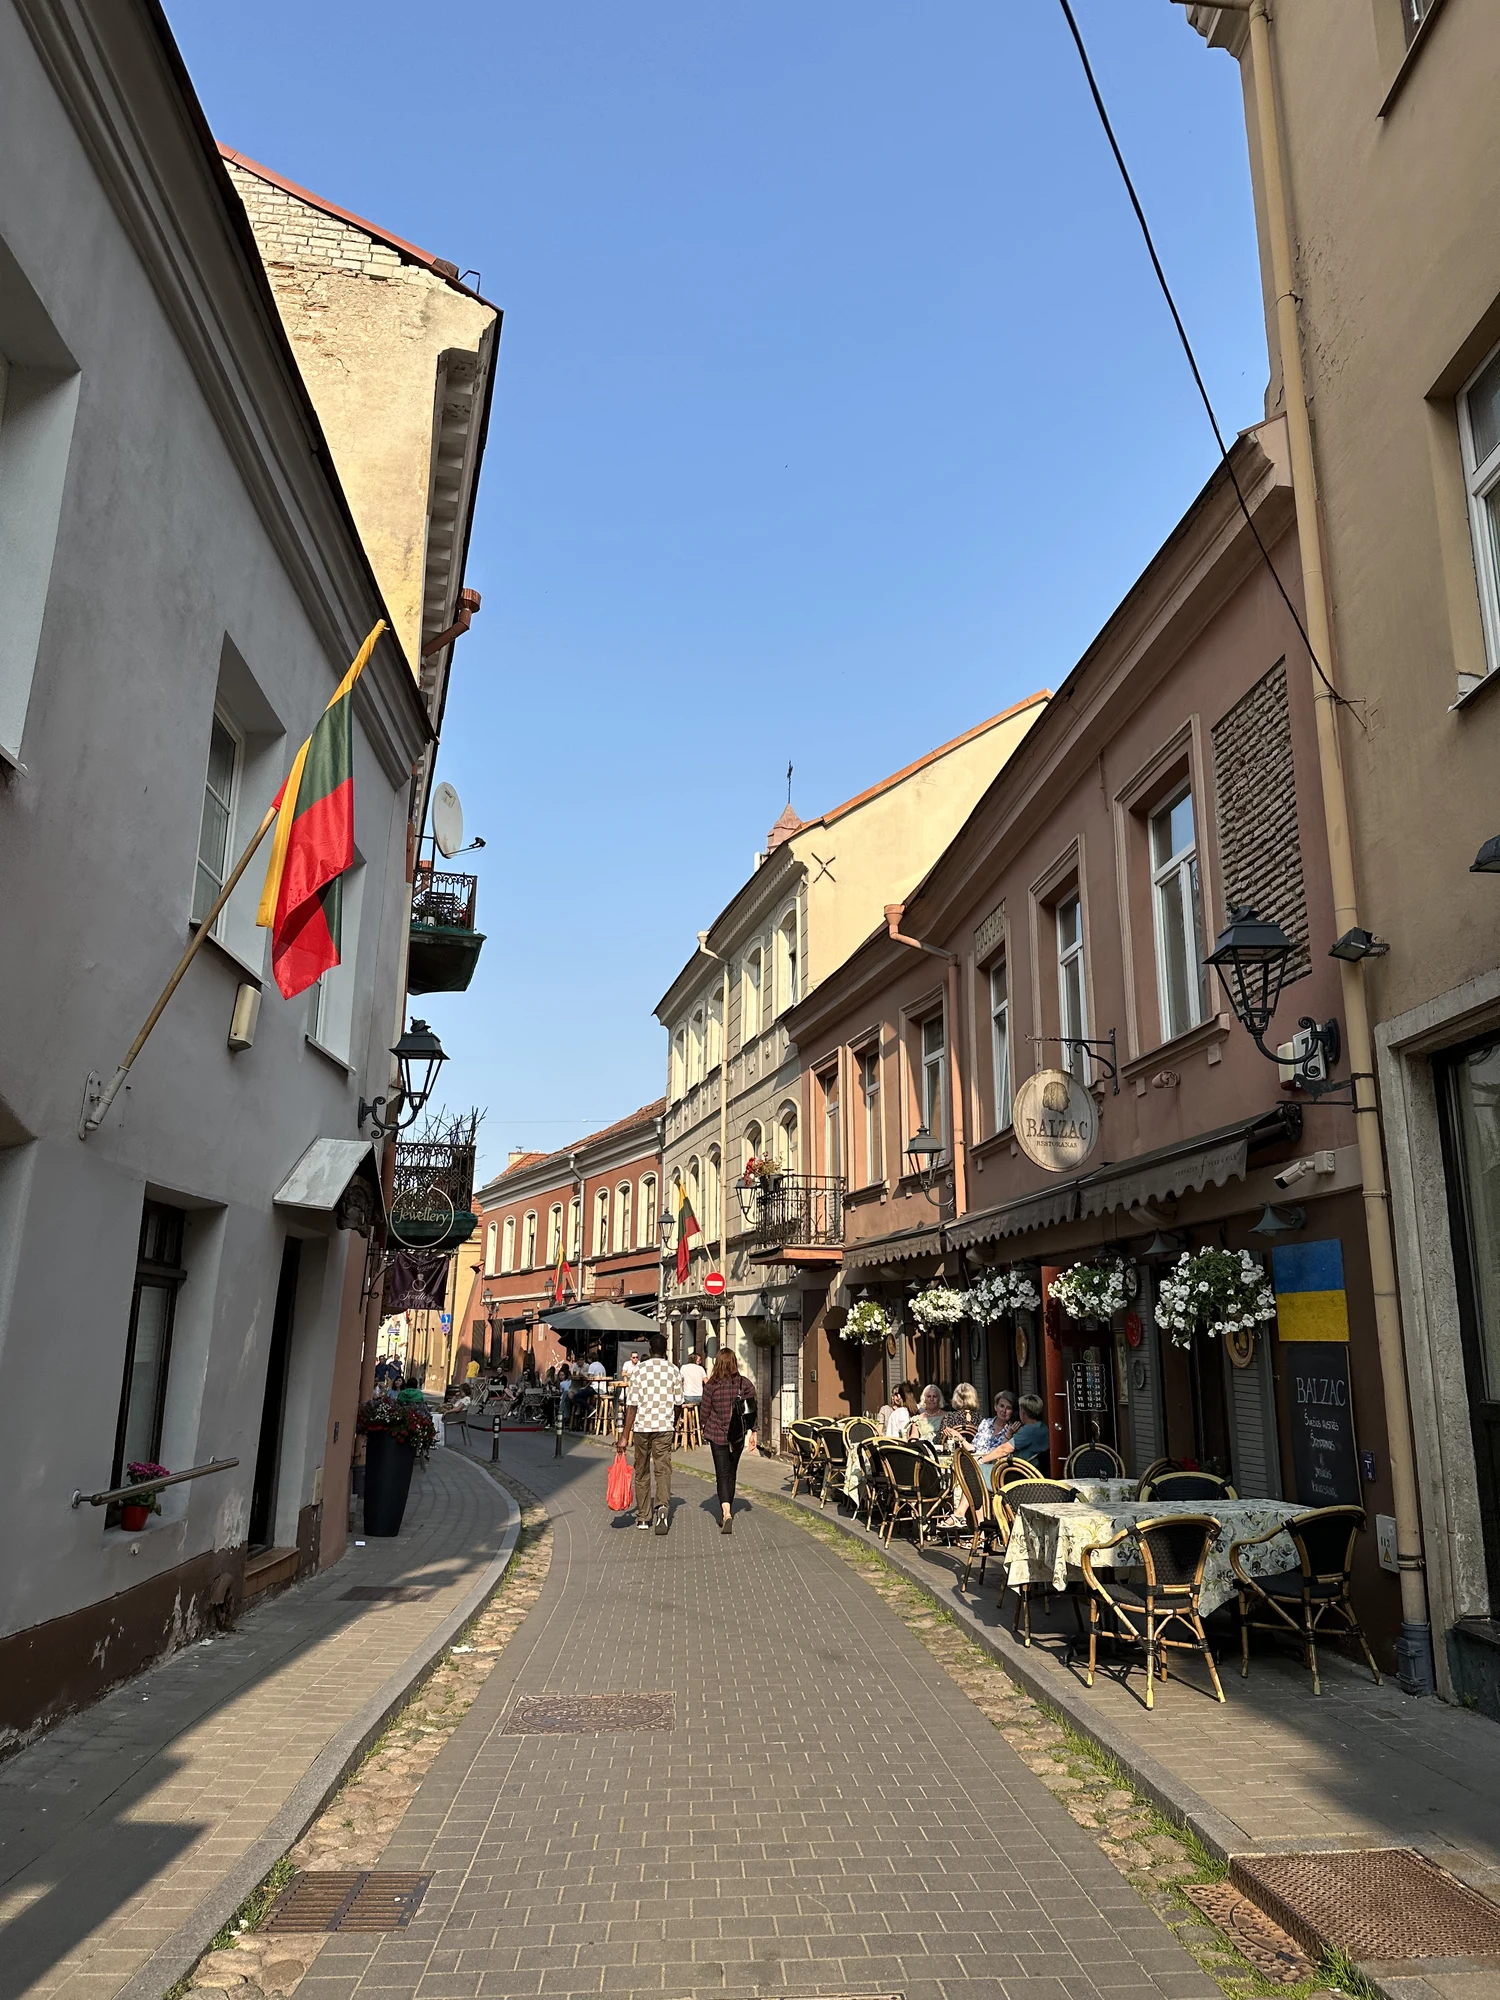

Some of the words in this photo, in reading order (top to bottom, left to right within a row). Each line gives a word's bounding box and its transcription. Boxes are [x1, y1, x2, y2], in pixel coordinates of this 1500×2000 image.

[1026, 1118, 1088, 1140] BALZAC
[1036, 1140, 1077, 1148] RESTORANAS
[395, 1207, 448, 1226] Jewellery
[1296, 1377, 1345, 1406] BALZAC
